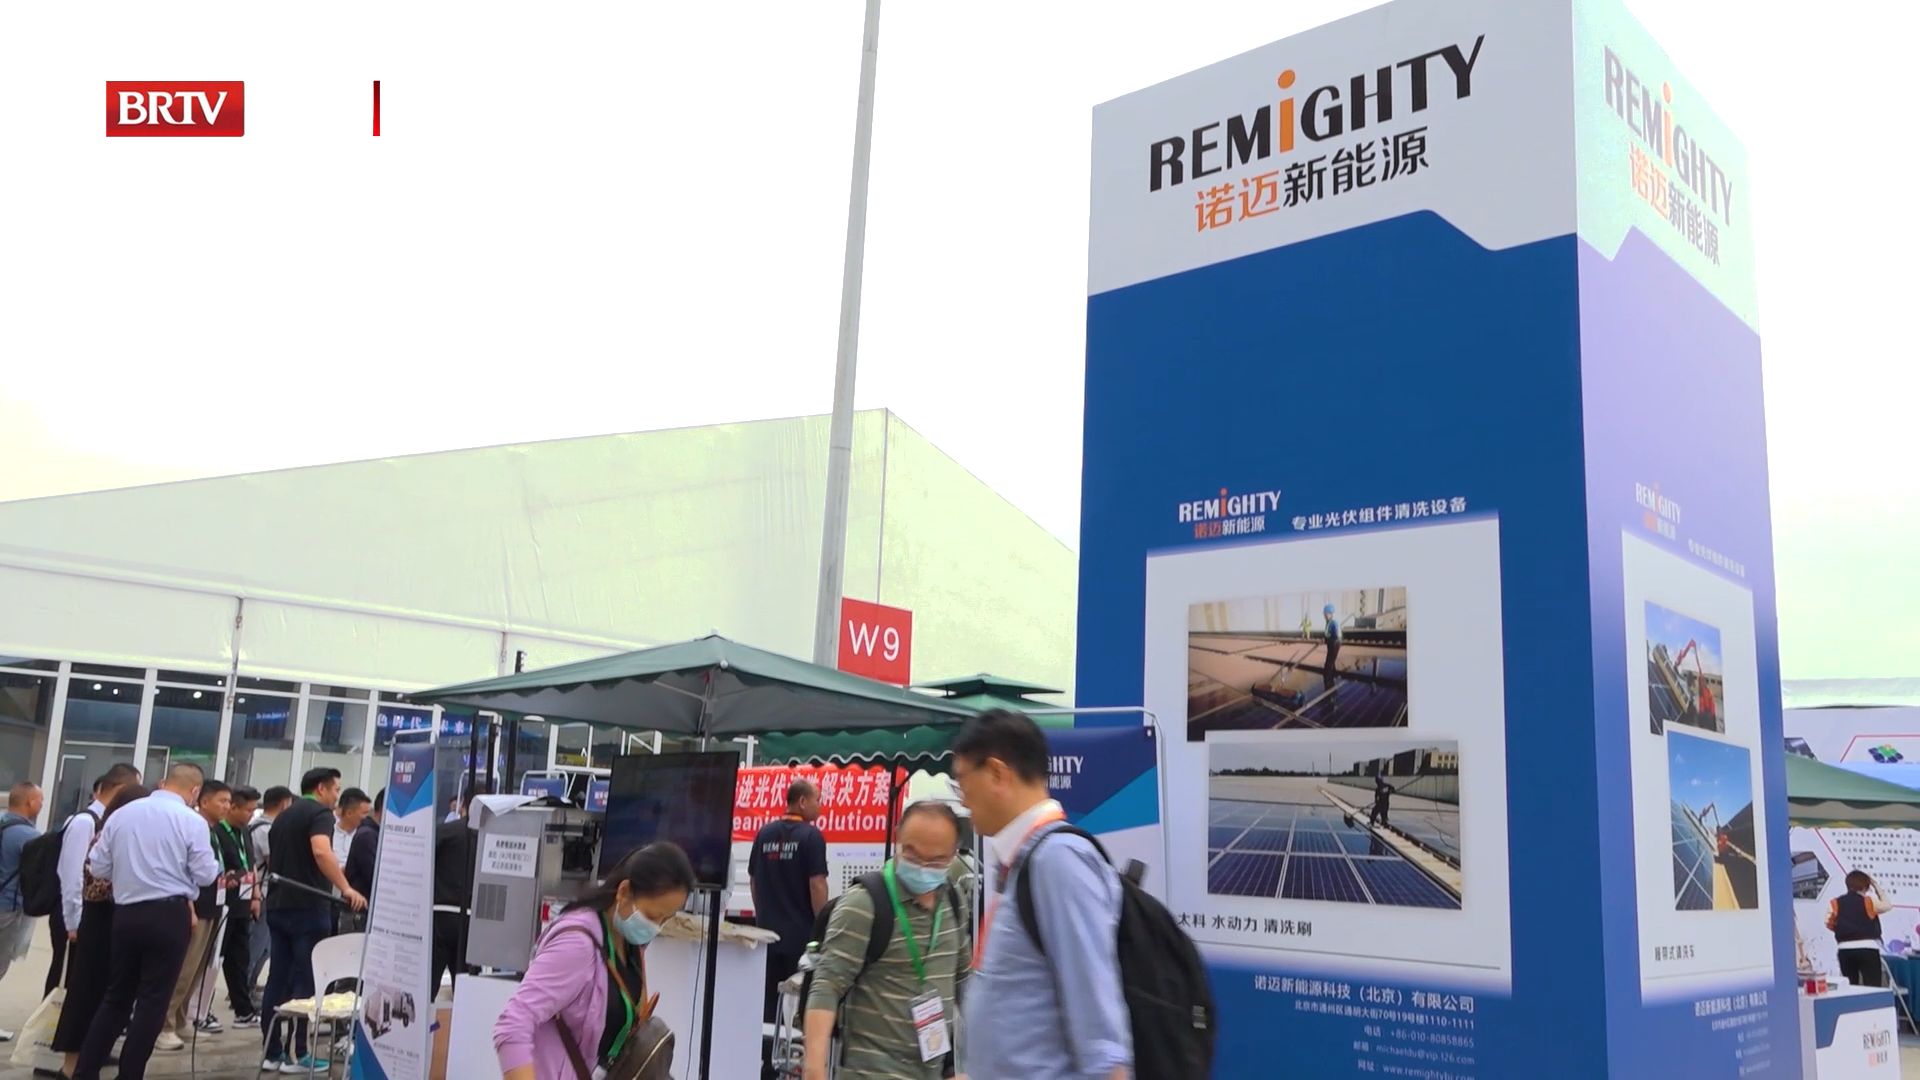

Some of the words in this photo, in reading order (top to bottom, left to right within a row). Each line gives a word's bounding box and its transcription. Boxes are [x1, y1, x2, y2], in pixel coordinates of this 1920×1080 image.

[1194, 126, 1430, 233] 诺迈新能源
[1629, 141, 1721, 267] 诺迈新能源
[1193, 515, 1266, 540] 诺迈新能源
[1291, 496, 1467, 532] 专业光伏组件清洗设备
[848, 619, 900, 662] W9
[736, 769, 892, 808] 进光伏解决方案
[811, 808, 887, 831] olution
[1212, 914, 1258, 932] 水动力
[1264, 917, 1312, 937] 清洗刷
